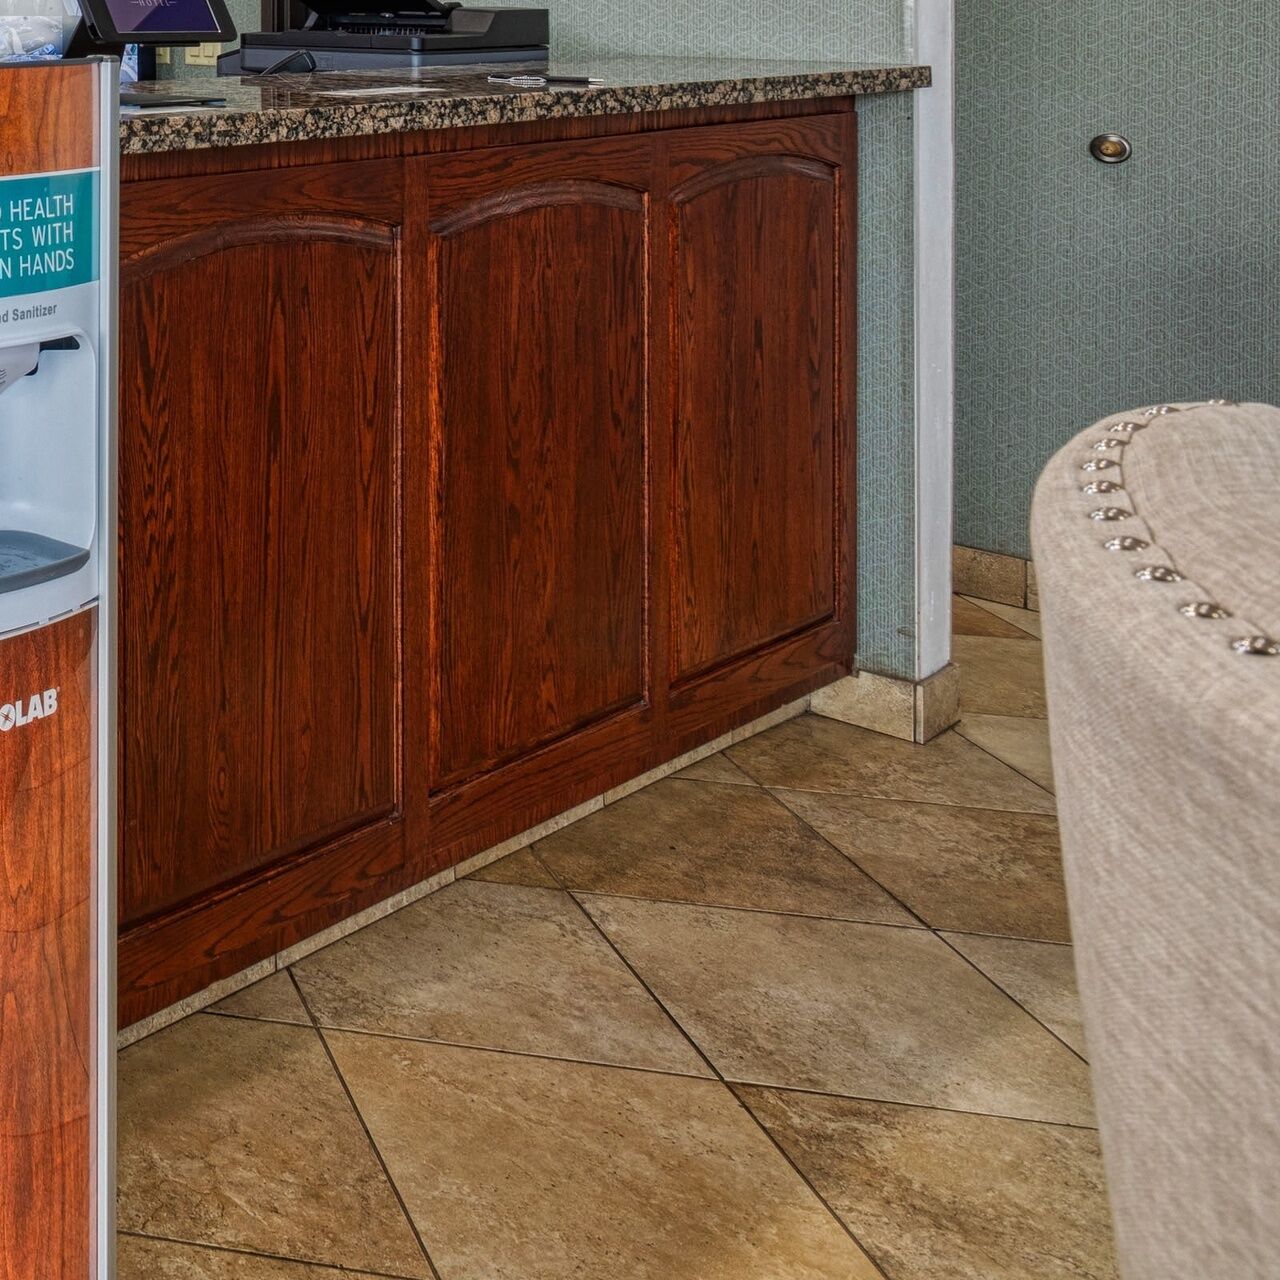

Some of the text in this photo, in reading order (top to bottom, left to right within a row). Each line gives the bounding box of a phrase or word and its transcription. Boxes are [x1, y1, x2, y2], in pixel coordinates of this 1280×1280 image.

[10, 194, 74, 222] HEALTH
[32, 221, 74, 248] WITH
[19, 248, 75, 277] HANDS
[12, 303, 58, 322] Sanitizer
